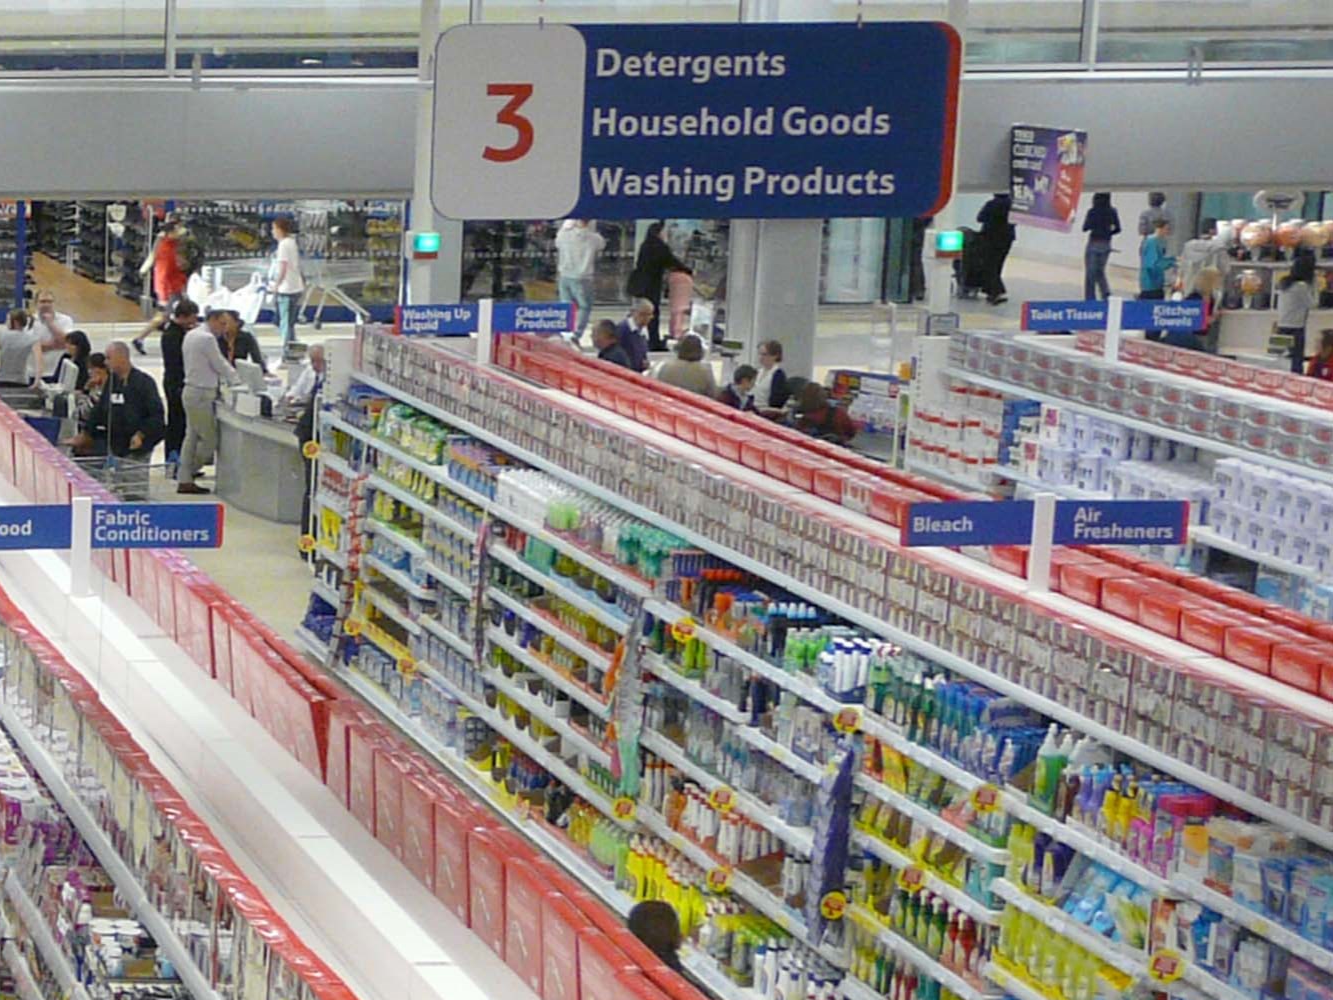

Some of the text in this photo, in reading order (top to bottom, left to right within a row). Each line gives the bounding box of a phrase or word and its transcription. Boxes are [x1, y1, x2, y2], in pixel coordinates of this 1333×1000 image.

[595, 48, 786, 84] Detergents
[482, 83, 534, 163] 3
[592, 107, 891, 137] Household Goods
[589, 167, 895, 201] Washing Products
[403, 308, 471, 325] Washing Up
[515, 307, 566, 322] Cleaning
[1031, 308, 1104, 321] Toilet Tissue
[1153, 305, 1200, 317] Kitchen
[403, 319, 439, 333] Liquid
[515, 318, 567, 331] Products
[1154, 315, 1192, 327] Towels
[95, 510, 151, 527] Fabric
[1074, 507, 1102, 523] Air
[912, 516, 973, 533] Bleach
[1074, 523, 1174, 540] Fresheners
[95, 525, 210, 543] Conditioners
